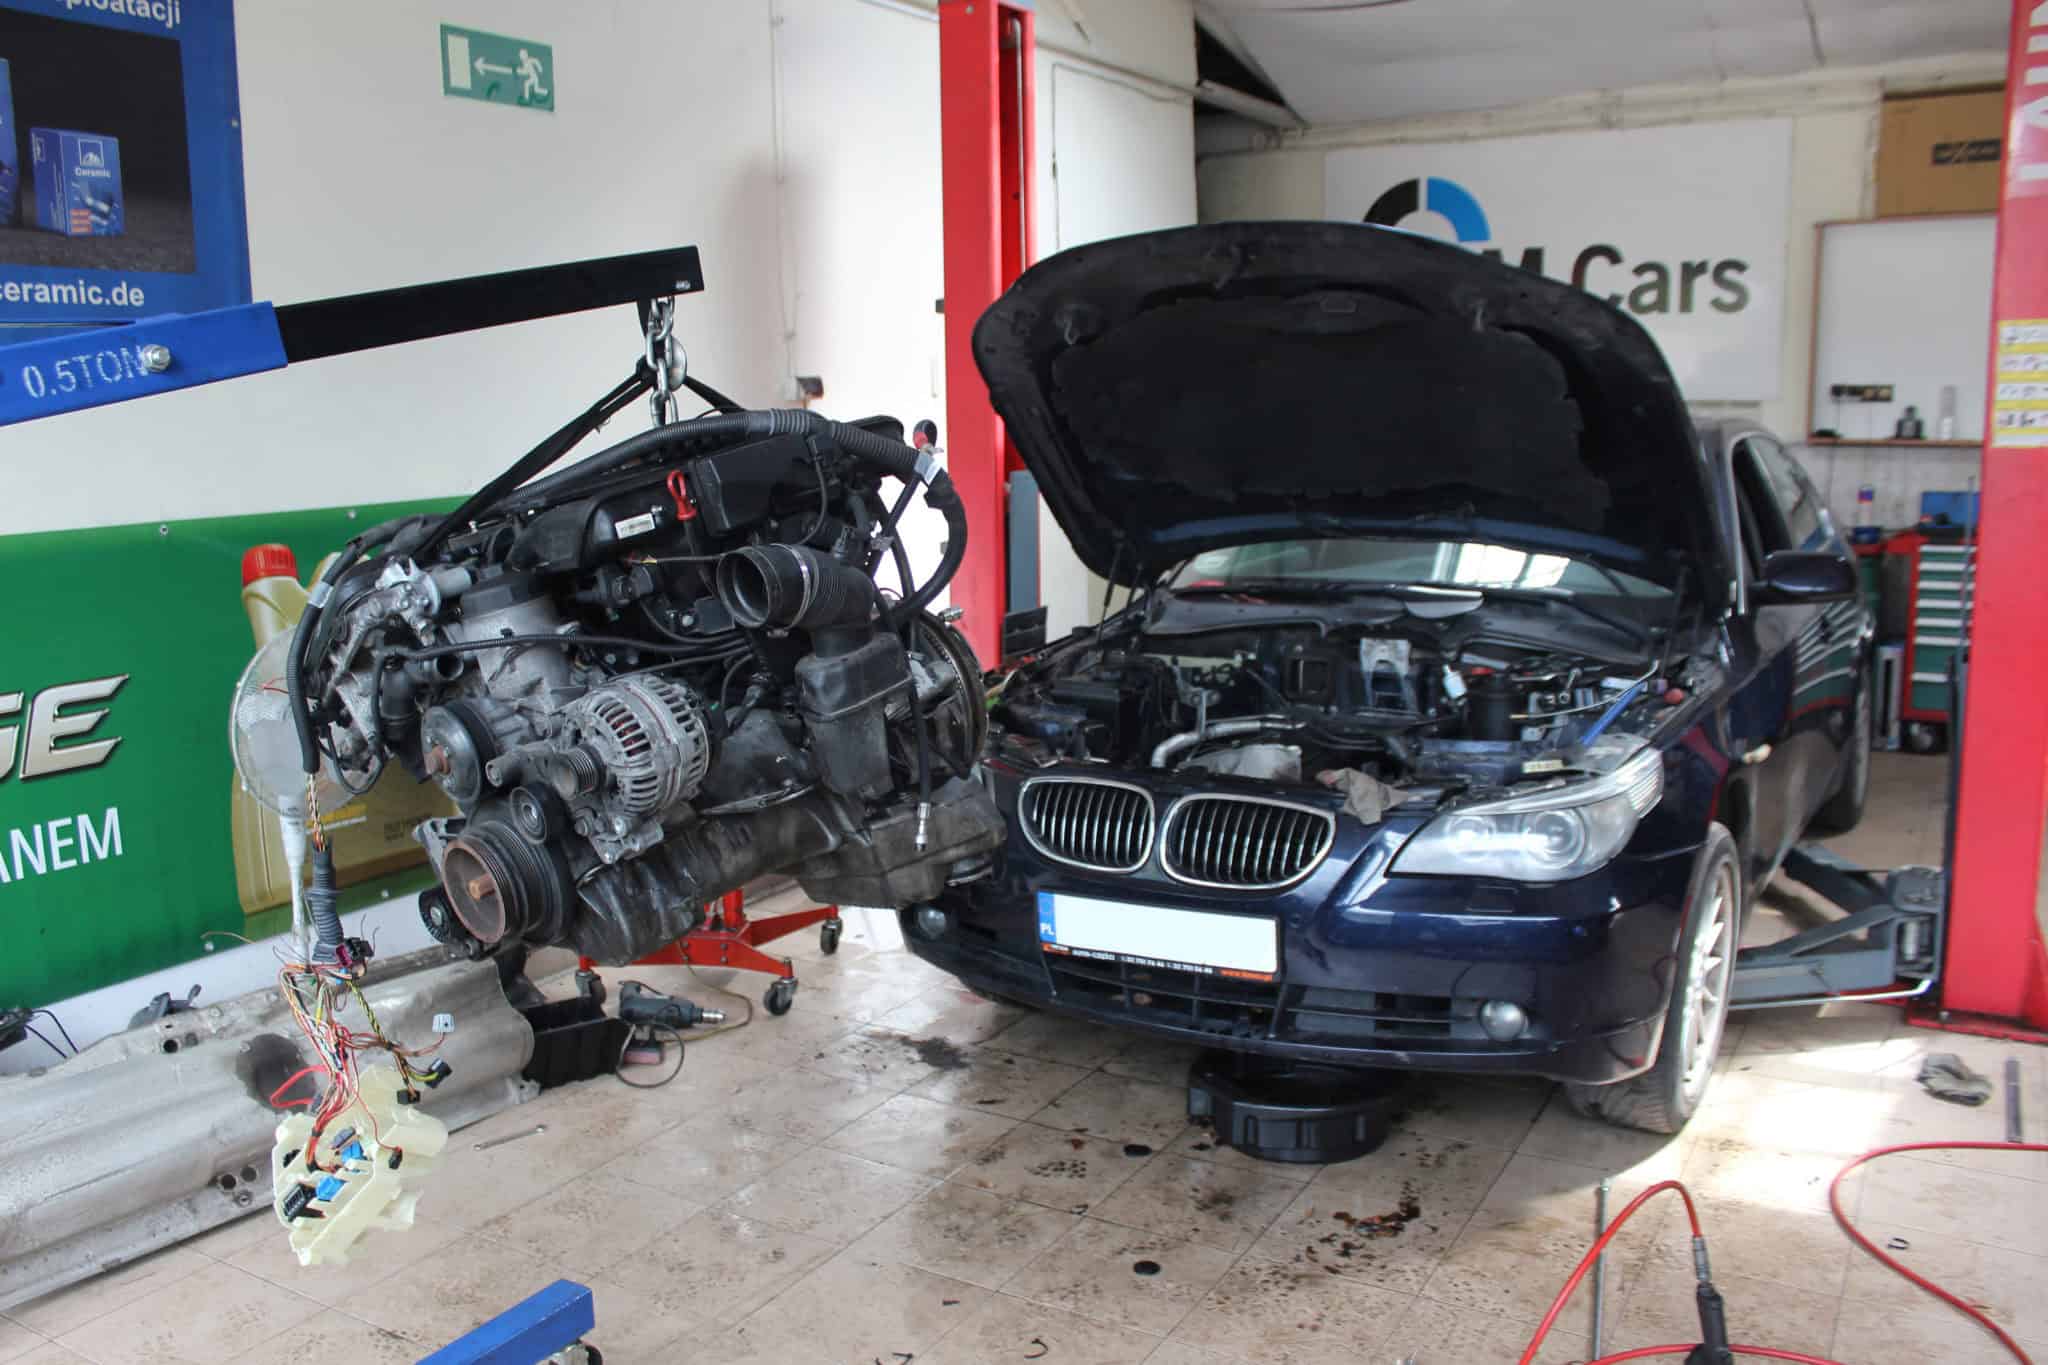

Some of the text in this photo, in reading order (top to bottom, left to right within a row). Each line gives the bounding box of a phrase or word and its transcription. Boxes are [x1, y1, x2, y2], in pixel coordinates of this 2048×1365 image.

[65, 0, 181, 28] oatacji
[0, 280, 145, 307] eramic.de
[1572, 244, 1750, 315] Cars
[0, 674, 129, 780] E
[1040, 923, 1056, 936] PL
